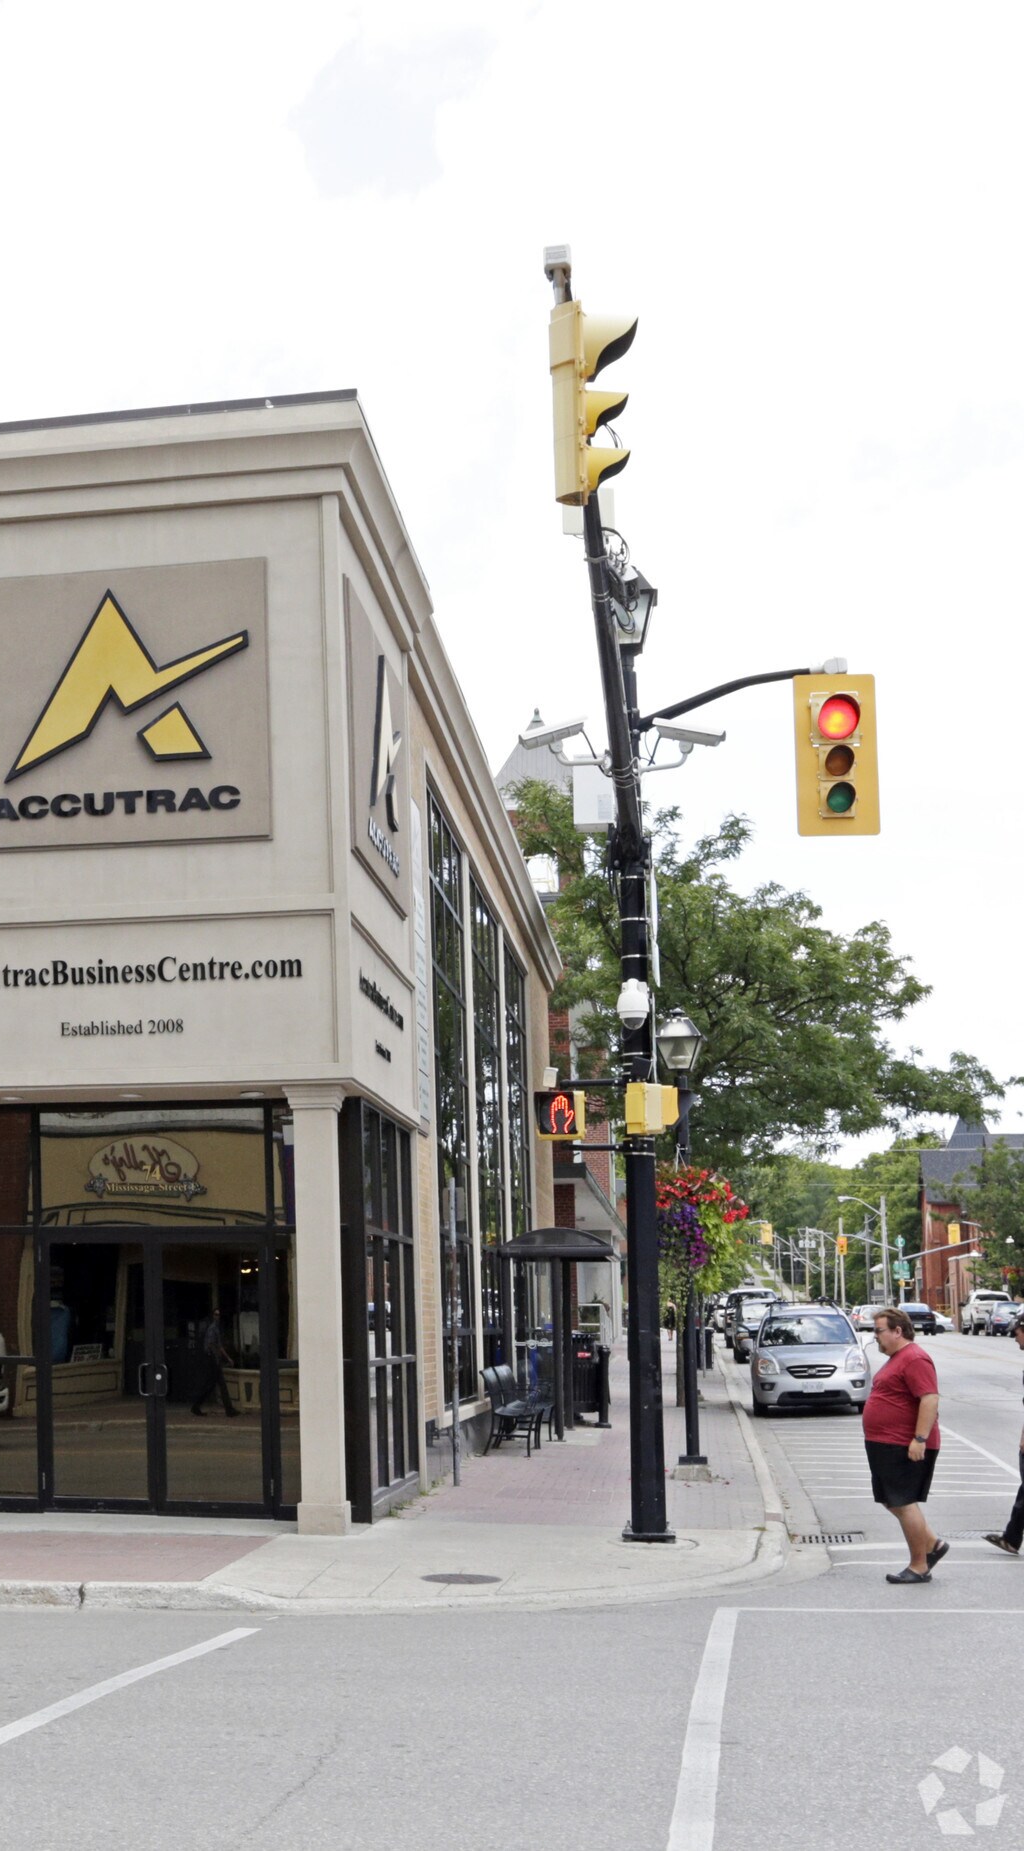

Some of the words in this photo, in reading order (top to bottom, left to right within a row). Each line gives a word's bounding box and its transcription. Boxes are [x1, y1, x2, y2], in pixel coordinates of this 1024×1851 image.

[60, 1020, 143, 1038] Established
[148, 1018, 184, 1035] 2008
[142, 1165, 161, 1181] 74
[105, 1183, 155, 1192] Mississaga
[159, 1183, 187, 1192] Street
